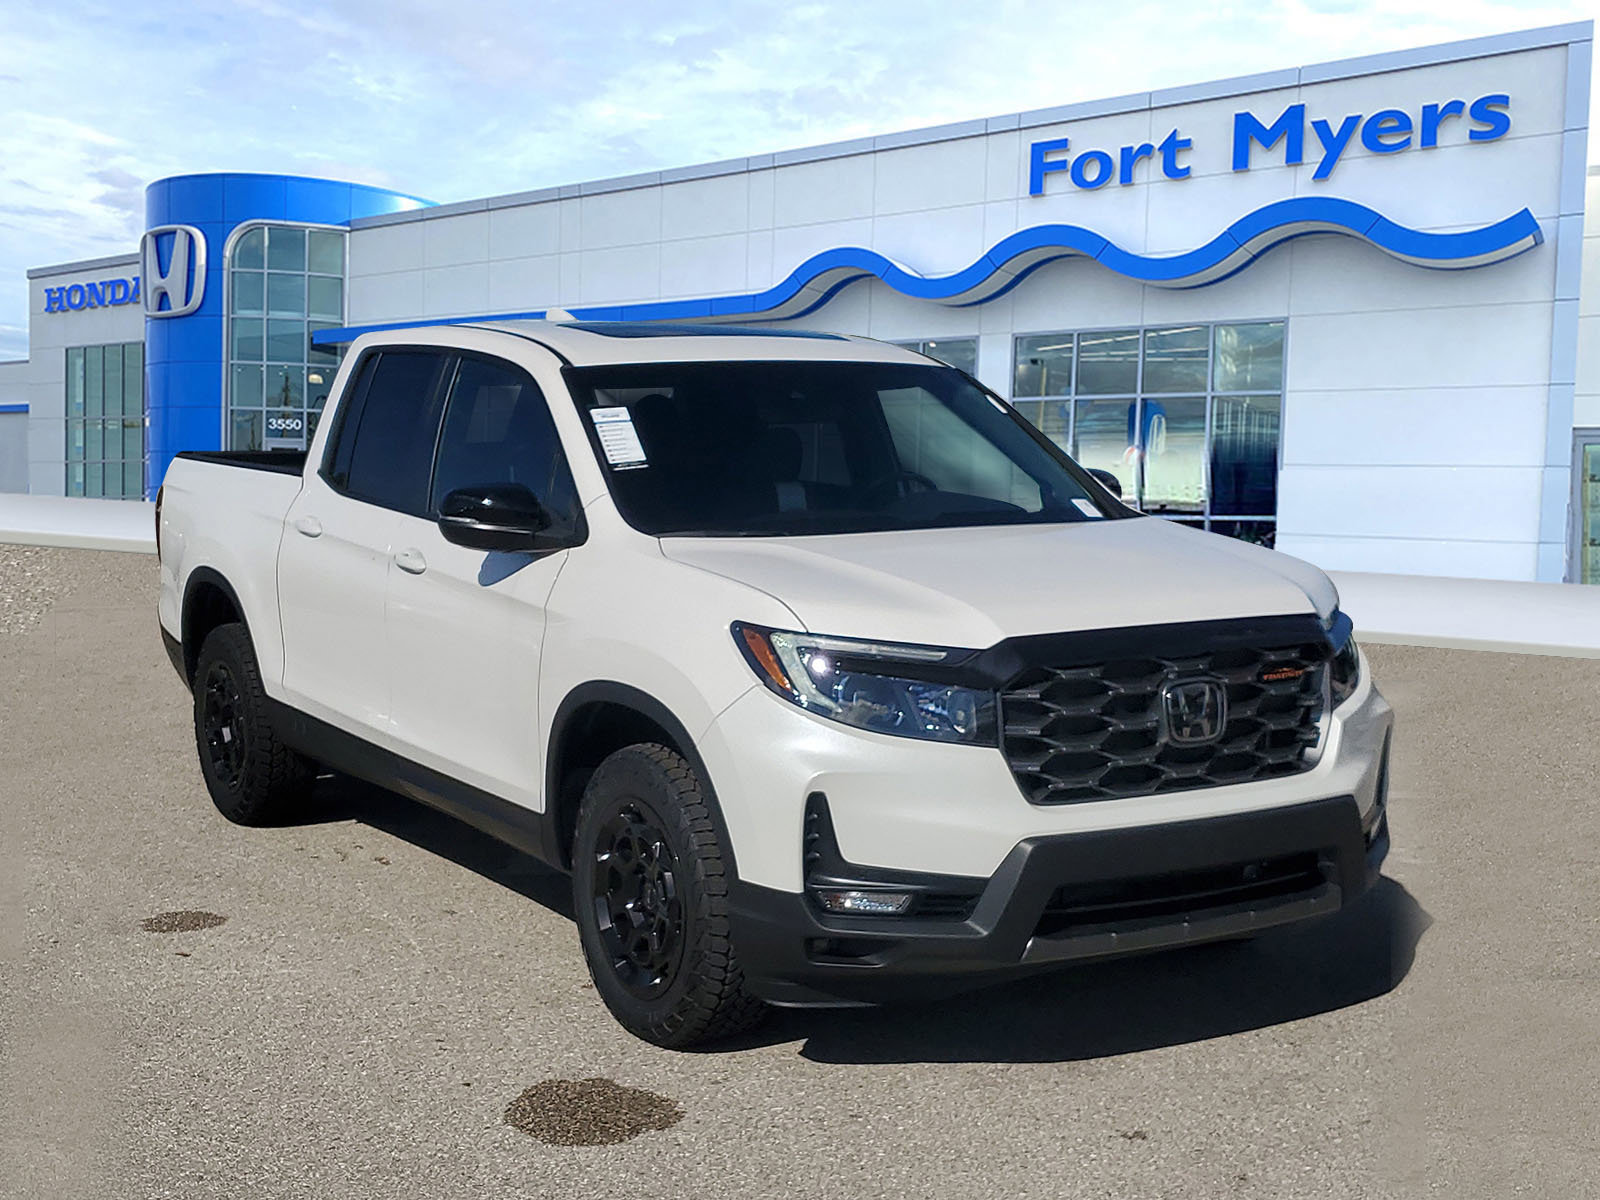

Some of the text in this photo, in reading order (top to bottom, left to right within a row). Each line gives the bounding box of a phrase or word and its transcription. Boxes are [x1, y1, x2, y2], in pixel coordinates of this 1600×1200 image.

[1028, 93, 1511, 196] Fort Myers
[268, 418, 302, 430] 3550
